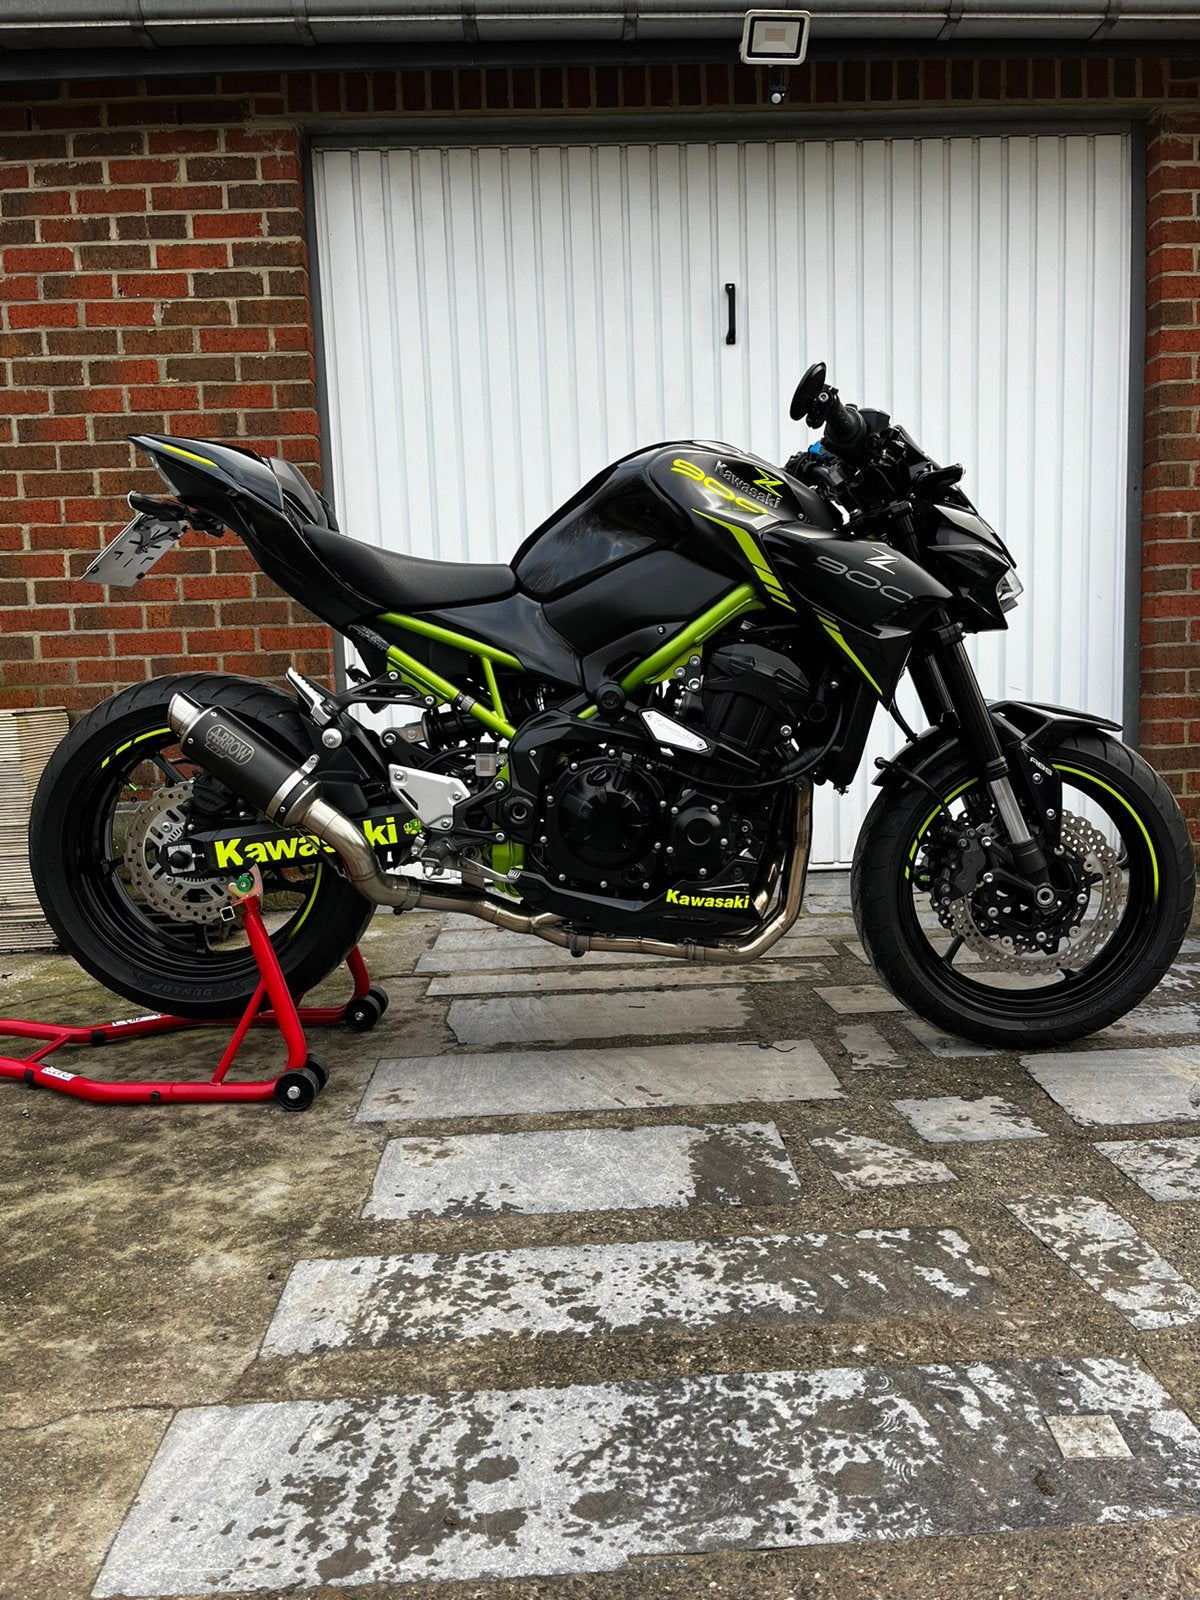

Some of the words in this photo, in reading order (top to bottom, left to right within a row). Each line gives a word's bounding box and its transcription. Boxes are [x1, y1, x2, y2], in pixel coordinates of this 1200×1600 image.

[671, 458, 768, 515] 900
[714, 460, 781, 509] Kawasaki
[812, 555, 915, 604] 900
[208, 727, 252, 761] ARROW
[214, 816, 399, 869] Kawaki
[665, 888, 750, 909] Kawasaki
[151, 982, 214, 997] DUNLOP
